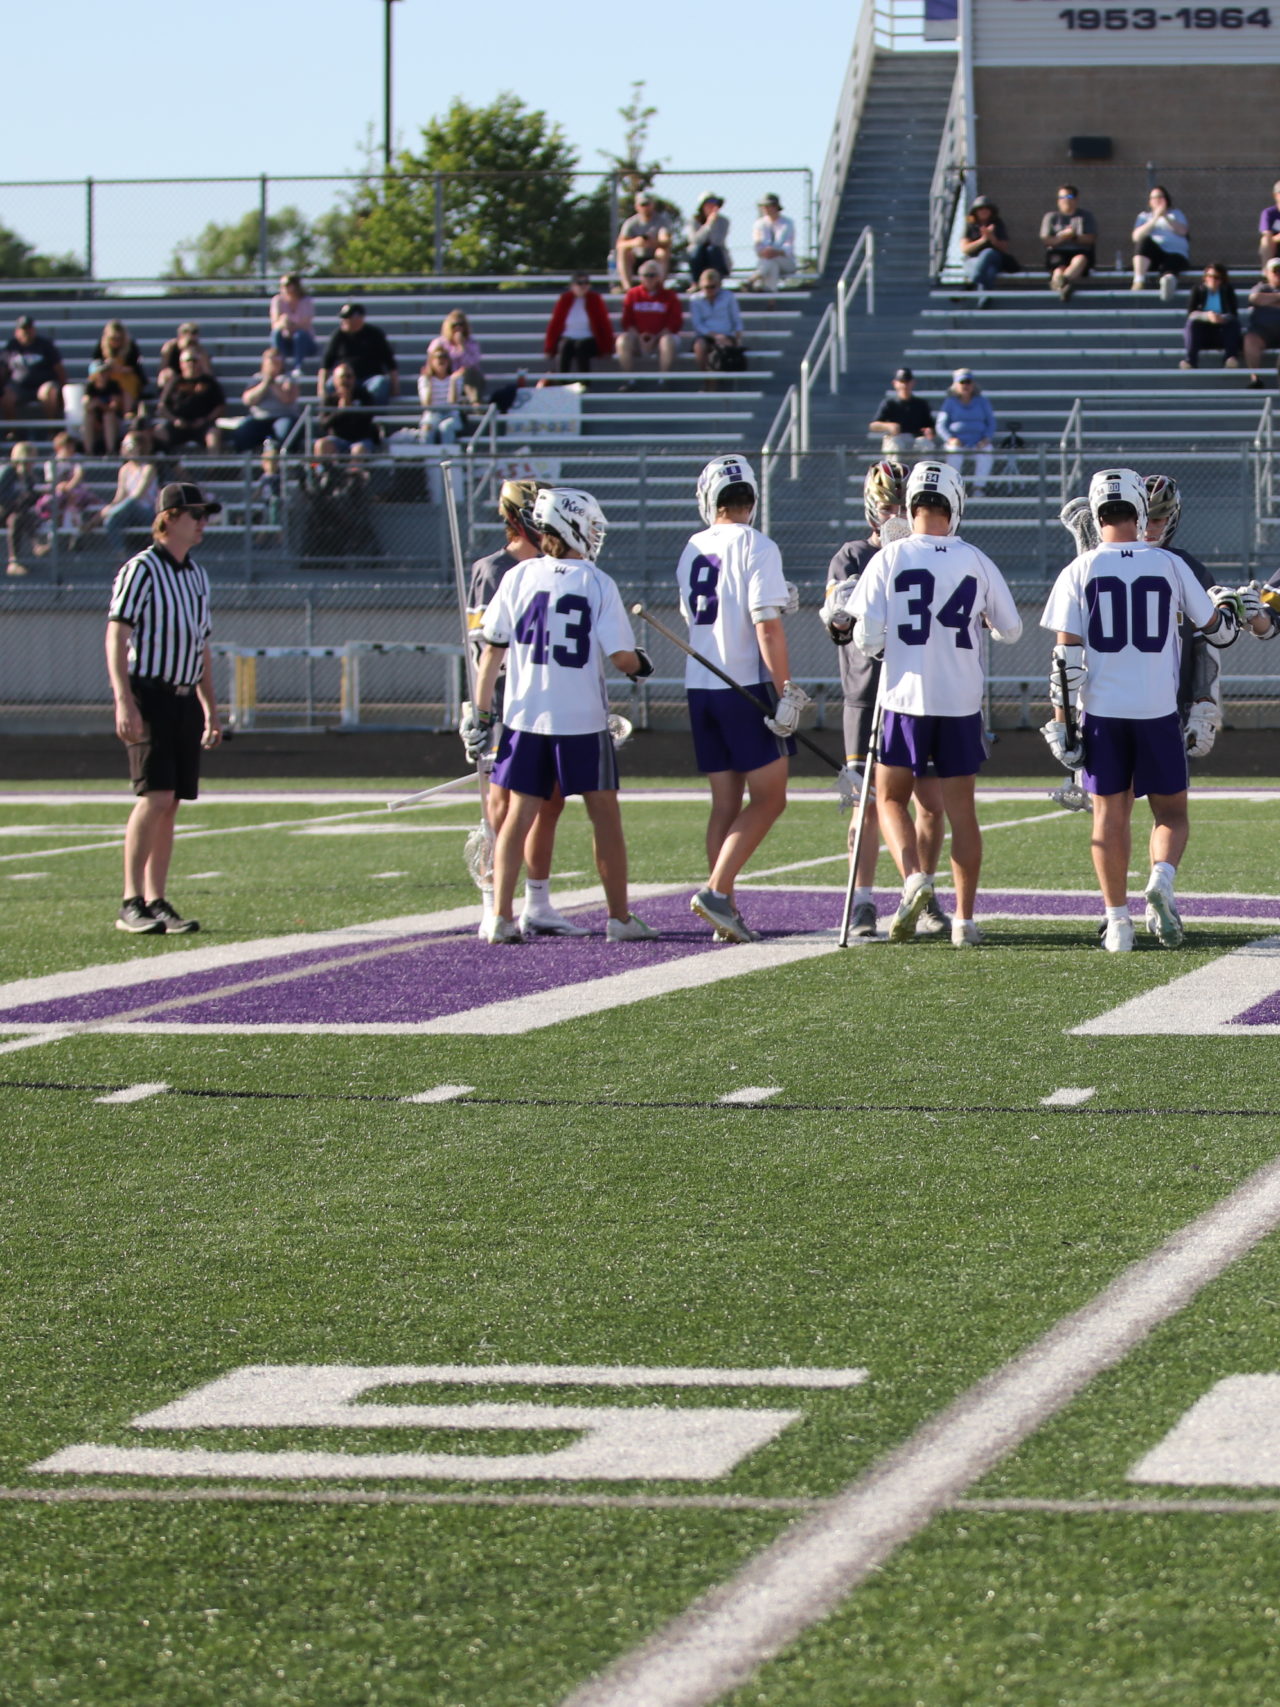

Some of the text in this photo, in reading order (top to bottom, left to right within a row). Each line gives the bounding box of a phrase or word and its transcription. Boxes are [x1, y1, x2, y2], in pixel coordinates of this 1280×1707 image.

[1058, 7, 1272, 30] 1953-1964
[688, 553, 722, 625] 8
[894, 568, 978, 650] 34
[1085, 575, 1172, 653] 00
[514, 590, 592, 669] 43
